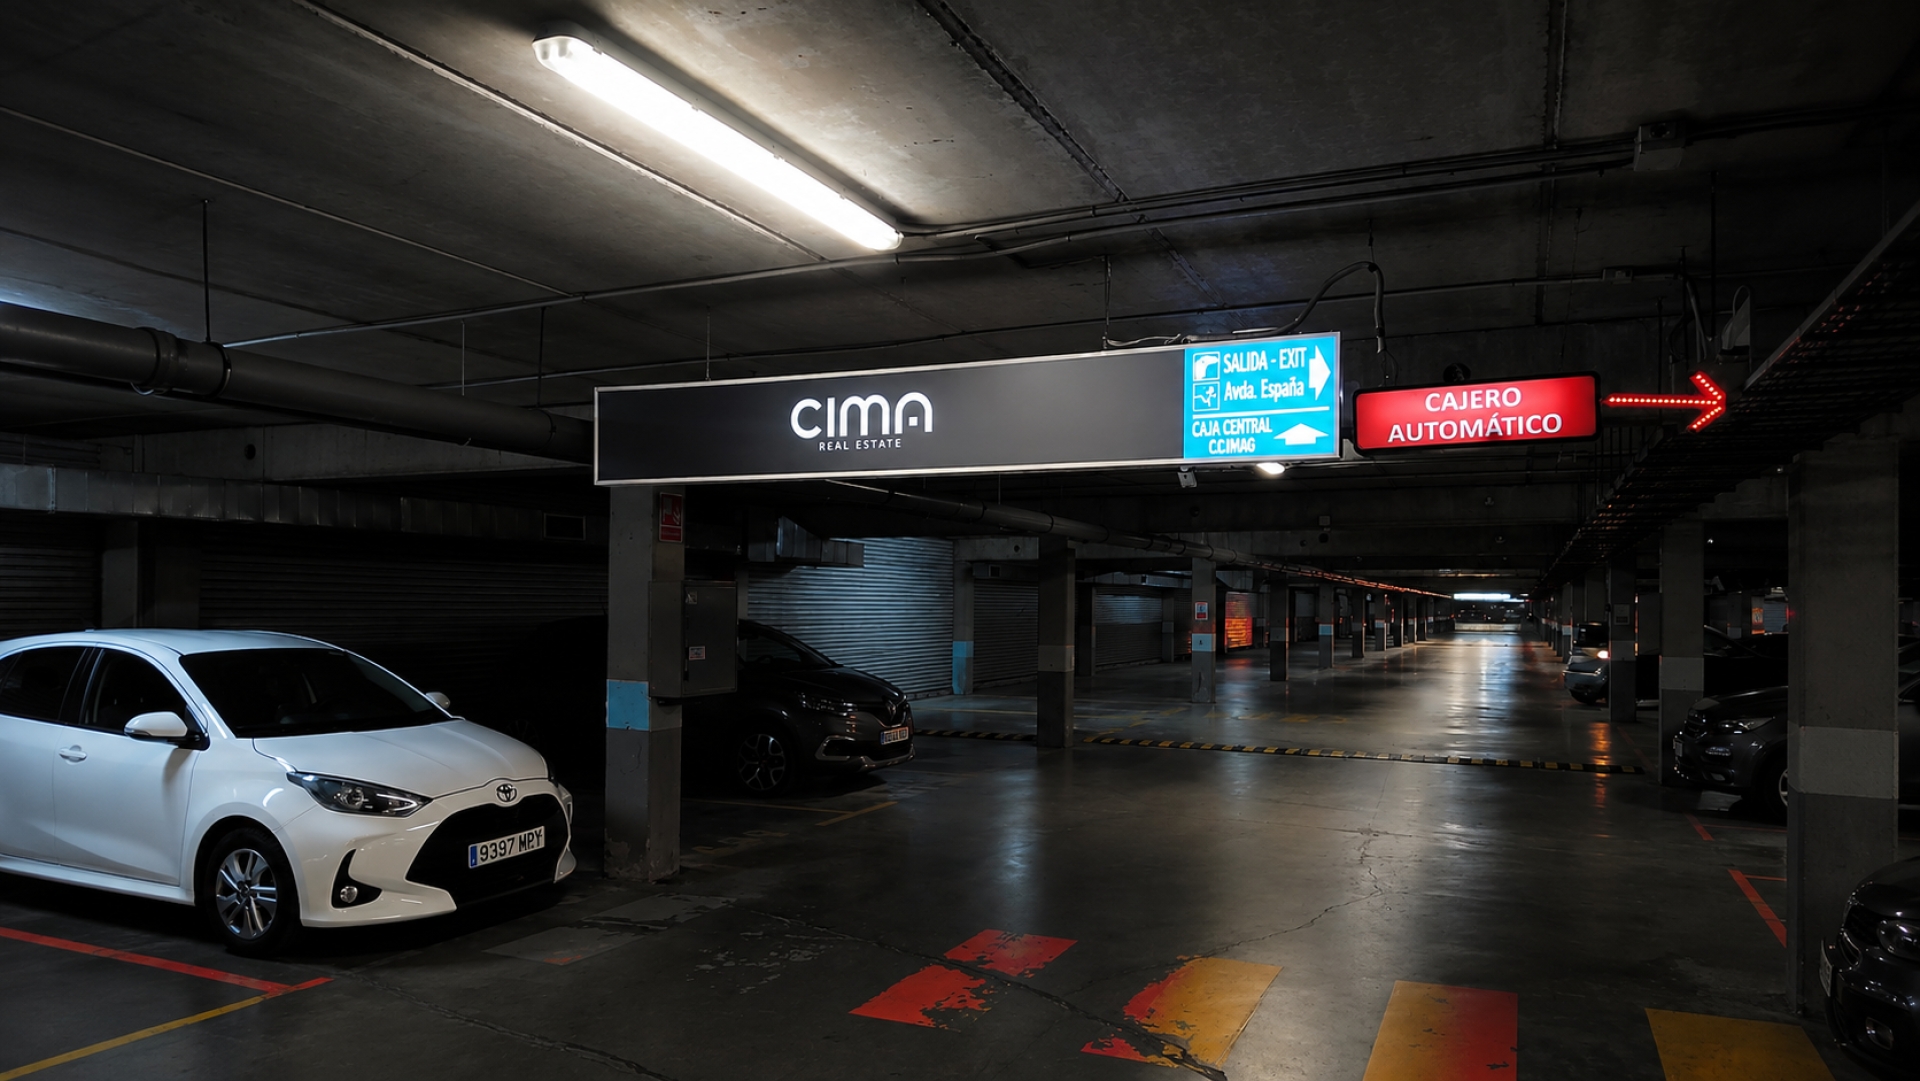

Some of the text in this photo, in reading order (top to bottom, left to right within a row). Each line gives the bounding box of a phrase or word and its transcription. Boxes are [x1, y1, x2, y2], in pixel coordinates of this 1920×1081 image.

[1223, 350, 1268, 373] SALIDA
[1279, 346, 1307, 370] EXIT
[1223, 376, 1305, 402] Avda. España
[1424, 387, 1522, 412] CAJERO
[790, 391, 933, 439] CIMA
[1192, 416, 1273, 437] CAJA CENTRAL
[1387, 412, 1563, 443] AUTOMÁTICO
[819, 438, 902, 451] REAL ESTATE
[479, 837, 515, 862] 9397
